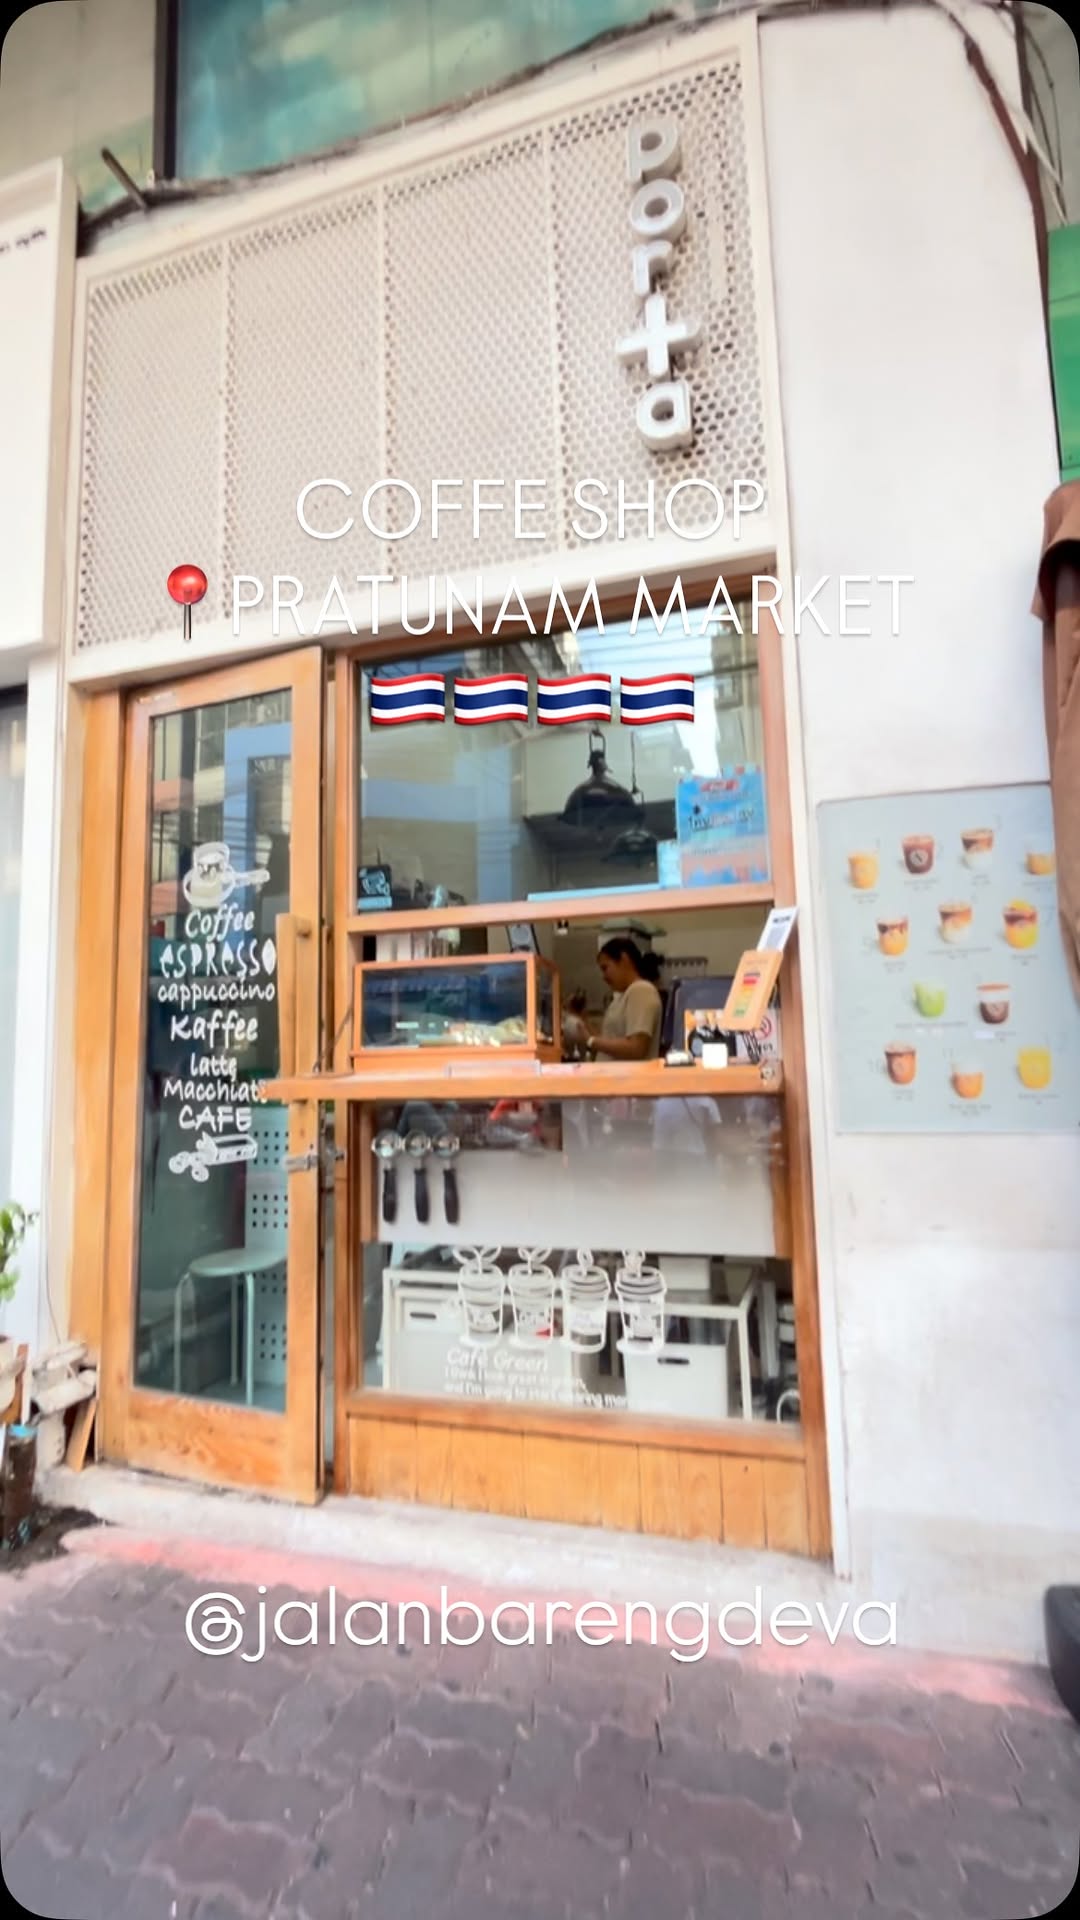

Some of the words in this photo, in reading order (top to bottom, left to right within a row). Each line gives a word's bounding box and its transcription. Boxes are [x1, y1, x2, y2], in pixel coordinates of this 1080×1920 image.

[616, 119, 702, 450] porta
[184, 904, 256, 942] Coffee
[157, 979, 276, 1011] cappuccino
[170, 1010, 259, 1049] Kaffee
[178, 1105, 252, 1132] CAFE
